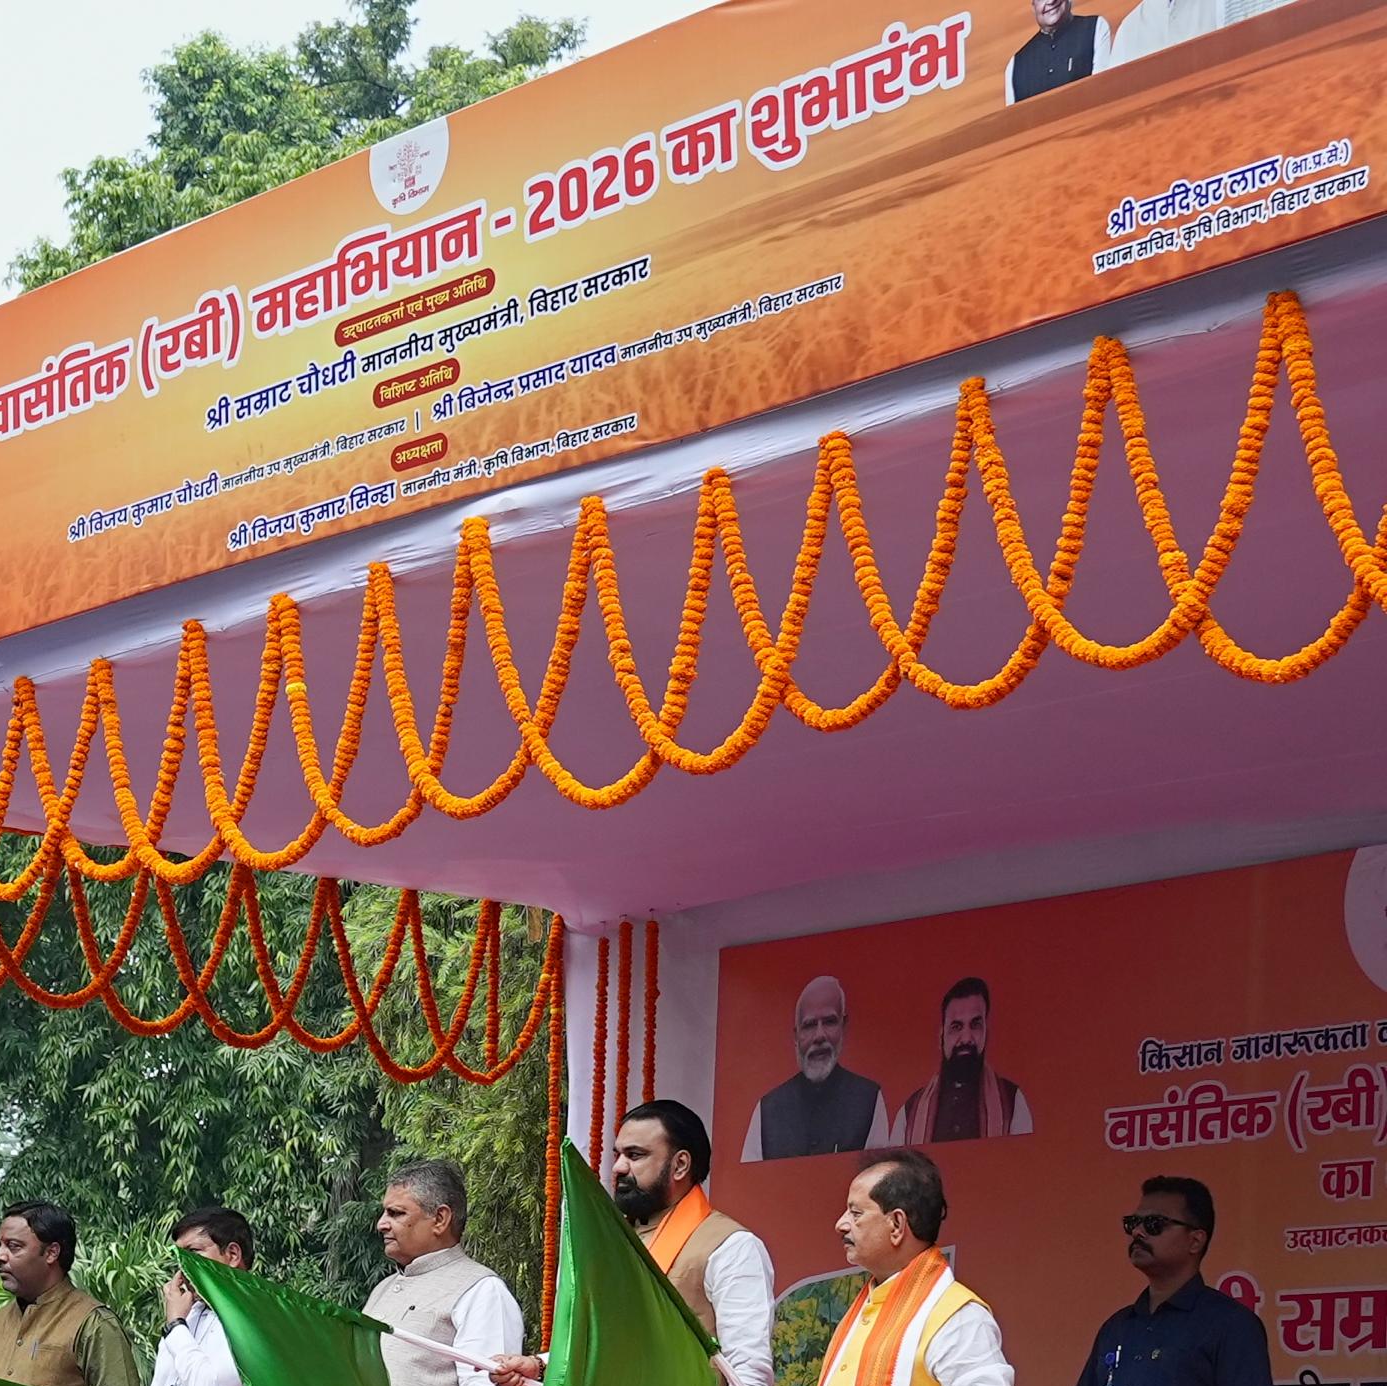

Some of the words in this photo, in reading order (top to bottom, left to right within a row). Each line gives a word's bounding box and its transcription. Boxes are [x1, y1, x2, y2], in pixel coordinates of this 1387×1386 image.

[139, 292, 241, 391] (रबी)
[252, 206, 482, 335] महाभियान
[527, 140, 655, 236] 2026
[665, 108, 737, 178] का
[750, 20, 965, 165] शुभारंभ
[1095, 244, 1134, 272] प्रधान
[1137, 231, 1179, 258] सचिव,
[1182, 217, 1213, 249] कृषि
[1216, 203, 1268, 231] विभाग,
[1271, 189, 1311, 216] बिहार
[1313, 169, 1368, 201] सरकार
[1108, 199, 1135, 235] श्री
[1226, 158, 1281, 195] लाल
[406, 295, 425, 318] एवं
[424, 290, 450, 313] मुख्य
[452, 274, 488, 299] अतिथि
[205, 396, 230, 431] श्री
[234, 384, 292, 421] सम्राट
[296, 349, 357, 397] चौधरी
[360, 327, 433, 373] माननीय
[438, 301, 526, 360] मुख्यमंत्री,
[528, 281, 579, 318] बिहार
[582, 256, 651, 299] सरकार
[431, 390, 456, 421] श्री
[457, 371, 515, 417] बिजेन्द्र
[518, 359, 566, 397] प्रसाद
[568, 345, 617, 378] यादव
[620, 327, 674, 362] माननीय
[675, 324, 694, 346] उप
[696, 300, 757, 343] मुख्यमंत्री,
[758, 288, 795, 317] बिहार
[796, 274, 844, 303] सरकार
[379, 372, 417, 402] विशिष्ट
[418, 363, 455, 389] अतिथि
[68, 518, 87, 542] श्री
[88, 506, 128, 536] विजय
[130, 491, 173, 526] कुमार
[177, 473, 219, 505] चौधरी
[220, 464, 264, 492] माननीय
[265, 460, 282, 476] उप
[335, 432, 365, 455] बिहार
[366, 419, 406, 443] सरकार
[228, 526, 248, 551] श्री
[251, 516, 295, 546] विजय
[298, 497, 345, 534] कुमार
[347, 482, 396, 511] सिन्हा
[401, 469, 450, 494] माननीय
[482, 452, 509, 479] कृषि
[512, 437, 556, 465] विभाग,
[557, 427, 591, 451] बिहार
[592, 413, 638, 440] सरकार
[393, 440, 444, 466] अध्यक्षता
[1139, 1038, 1225, 1073] किसान
[1230, 1021, 1369, 1062] जागरूकता
[1106, 1083, 1278, 1149] वासंतिक
[1321, 1159, 1375, 1200] का
